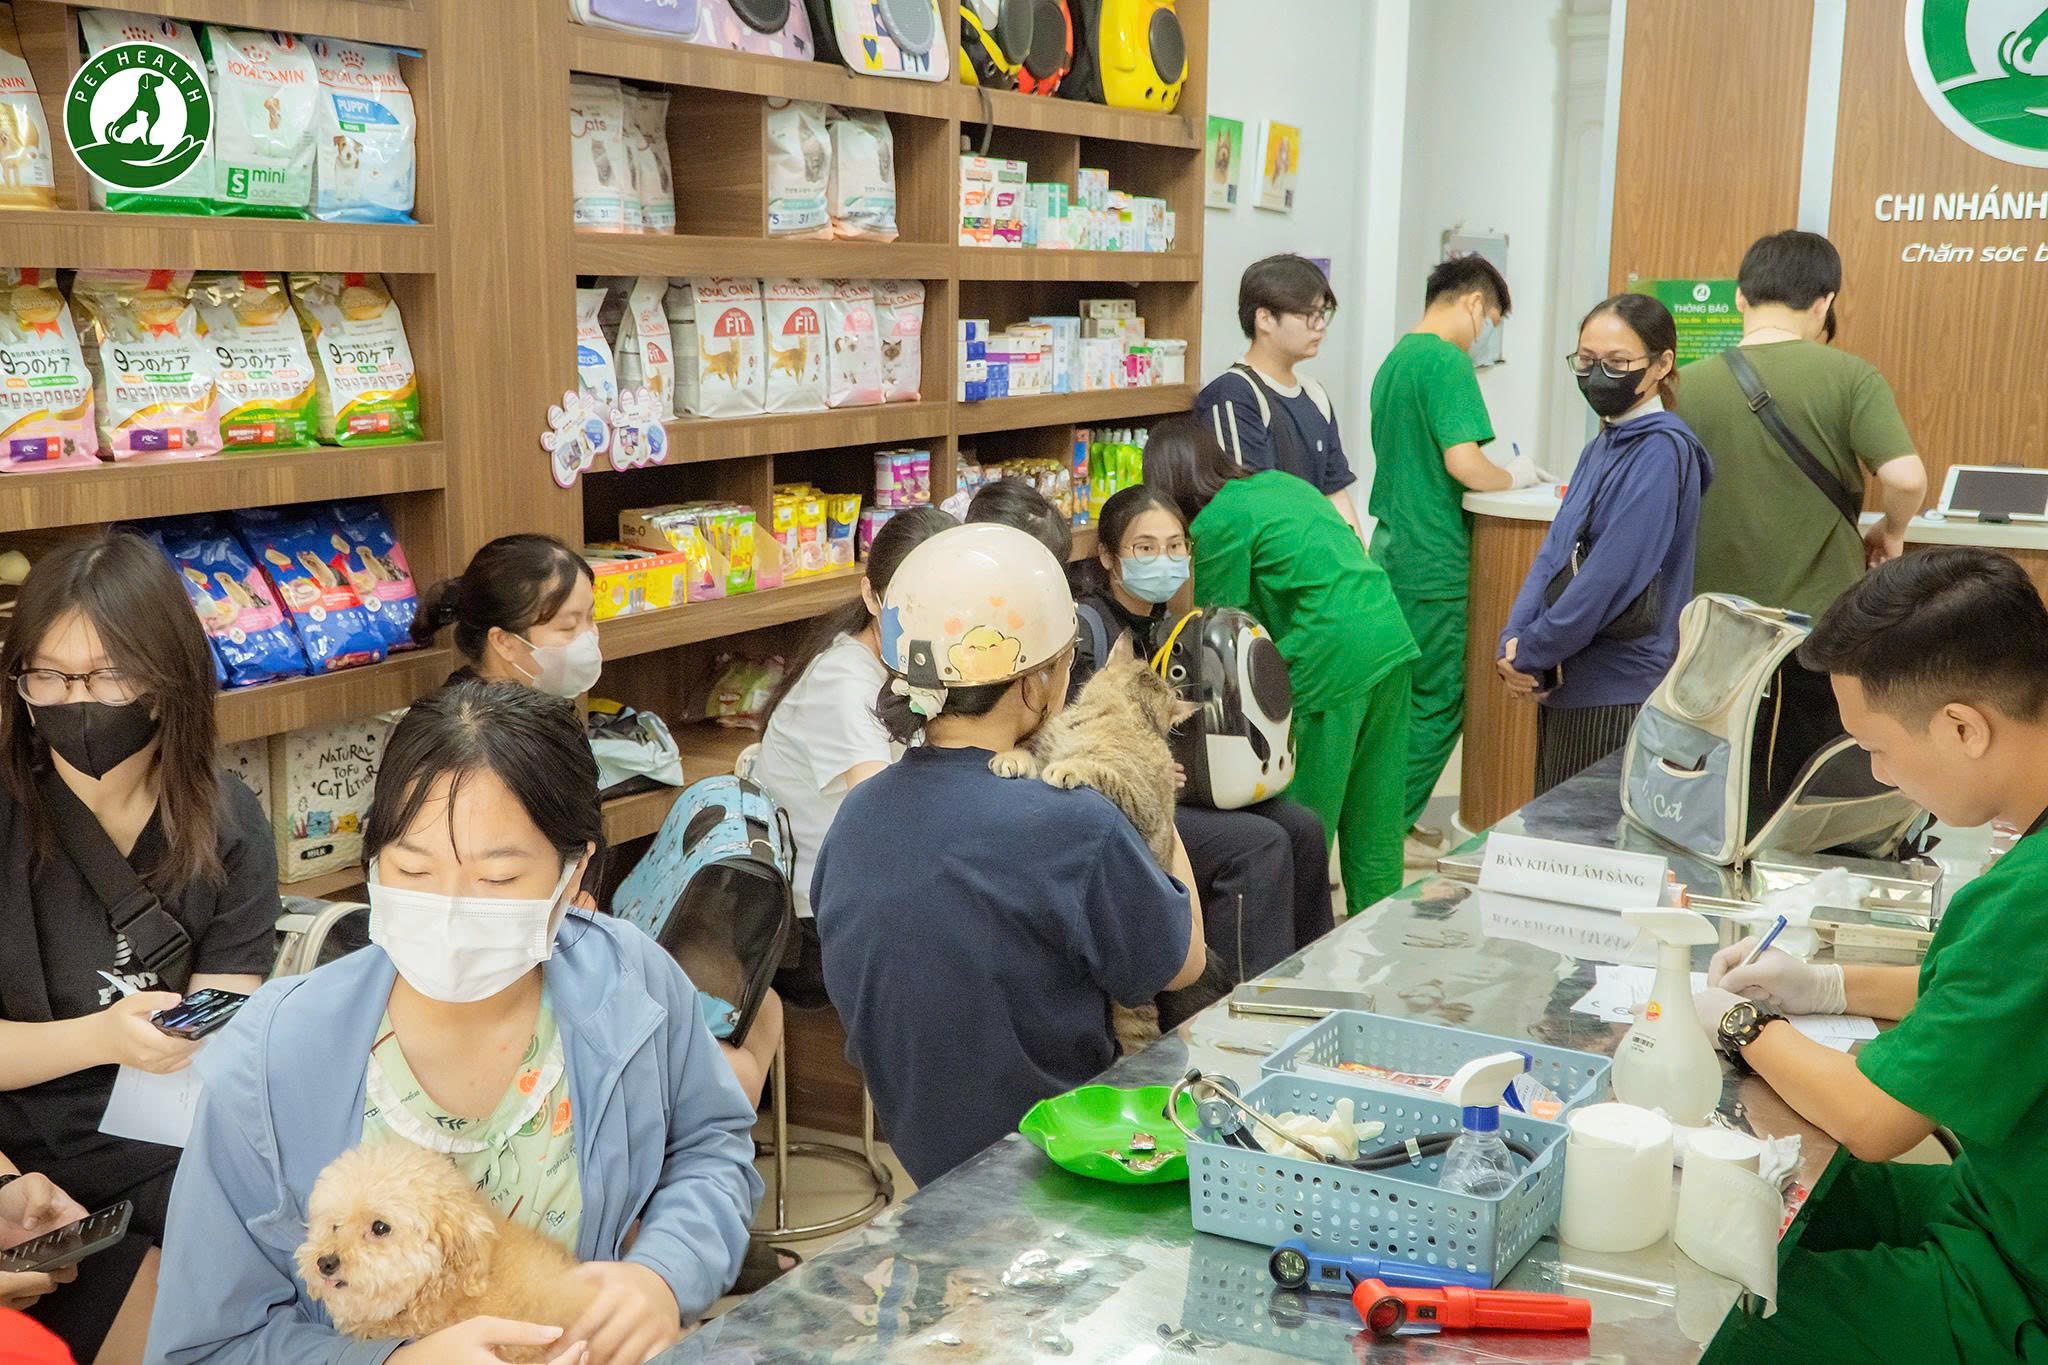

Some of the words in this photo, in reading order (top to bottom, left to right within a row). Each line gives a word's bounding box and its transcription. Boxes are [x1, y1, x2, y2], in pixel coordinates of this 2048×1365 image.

[337, 98, 369, 115] PUPPY
[231, 172, 245, 194] S
[251, 167, 286, 185] mini
[1874, 192, 1926, 222] CHI
[1932, 184, 2048, 221] NHÁNH
[1901, 242, 1975, 263] Chăm
[1673, 303, 1707, 314] THÔNG
[1707, 303, 1730, 314] BÁO
[725, 316, 746, 334] FIT
[794, 314, 816, 333] FIT
[113, 347, 191, 373] 9つのケア
[318, 743, 376, 769] NATURAL
[316, 778, 342, 800] CAT
[345, 764, 379, 799] LITTER
[332, 763, 360, 780] TOFU
[1653, 793, 1684, 823] Cat
